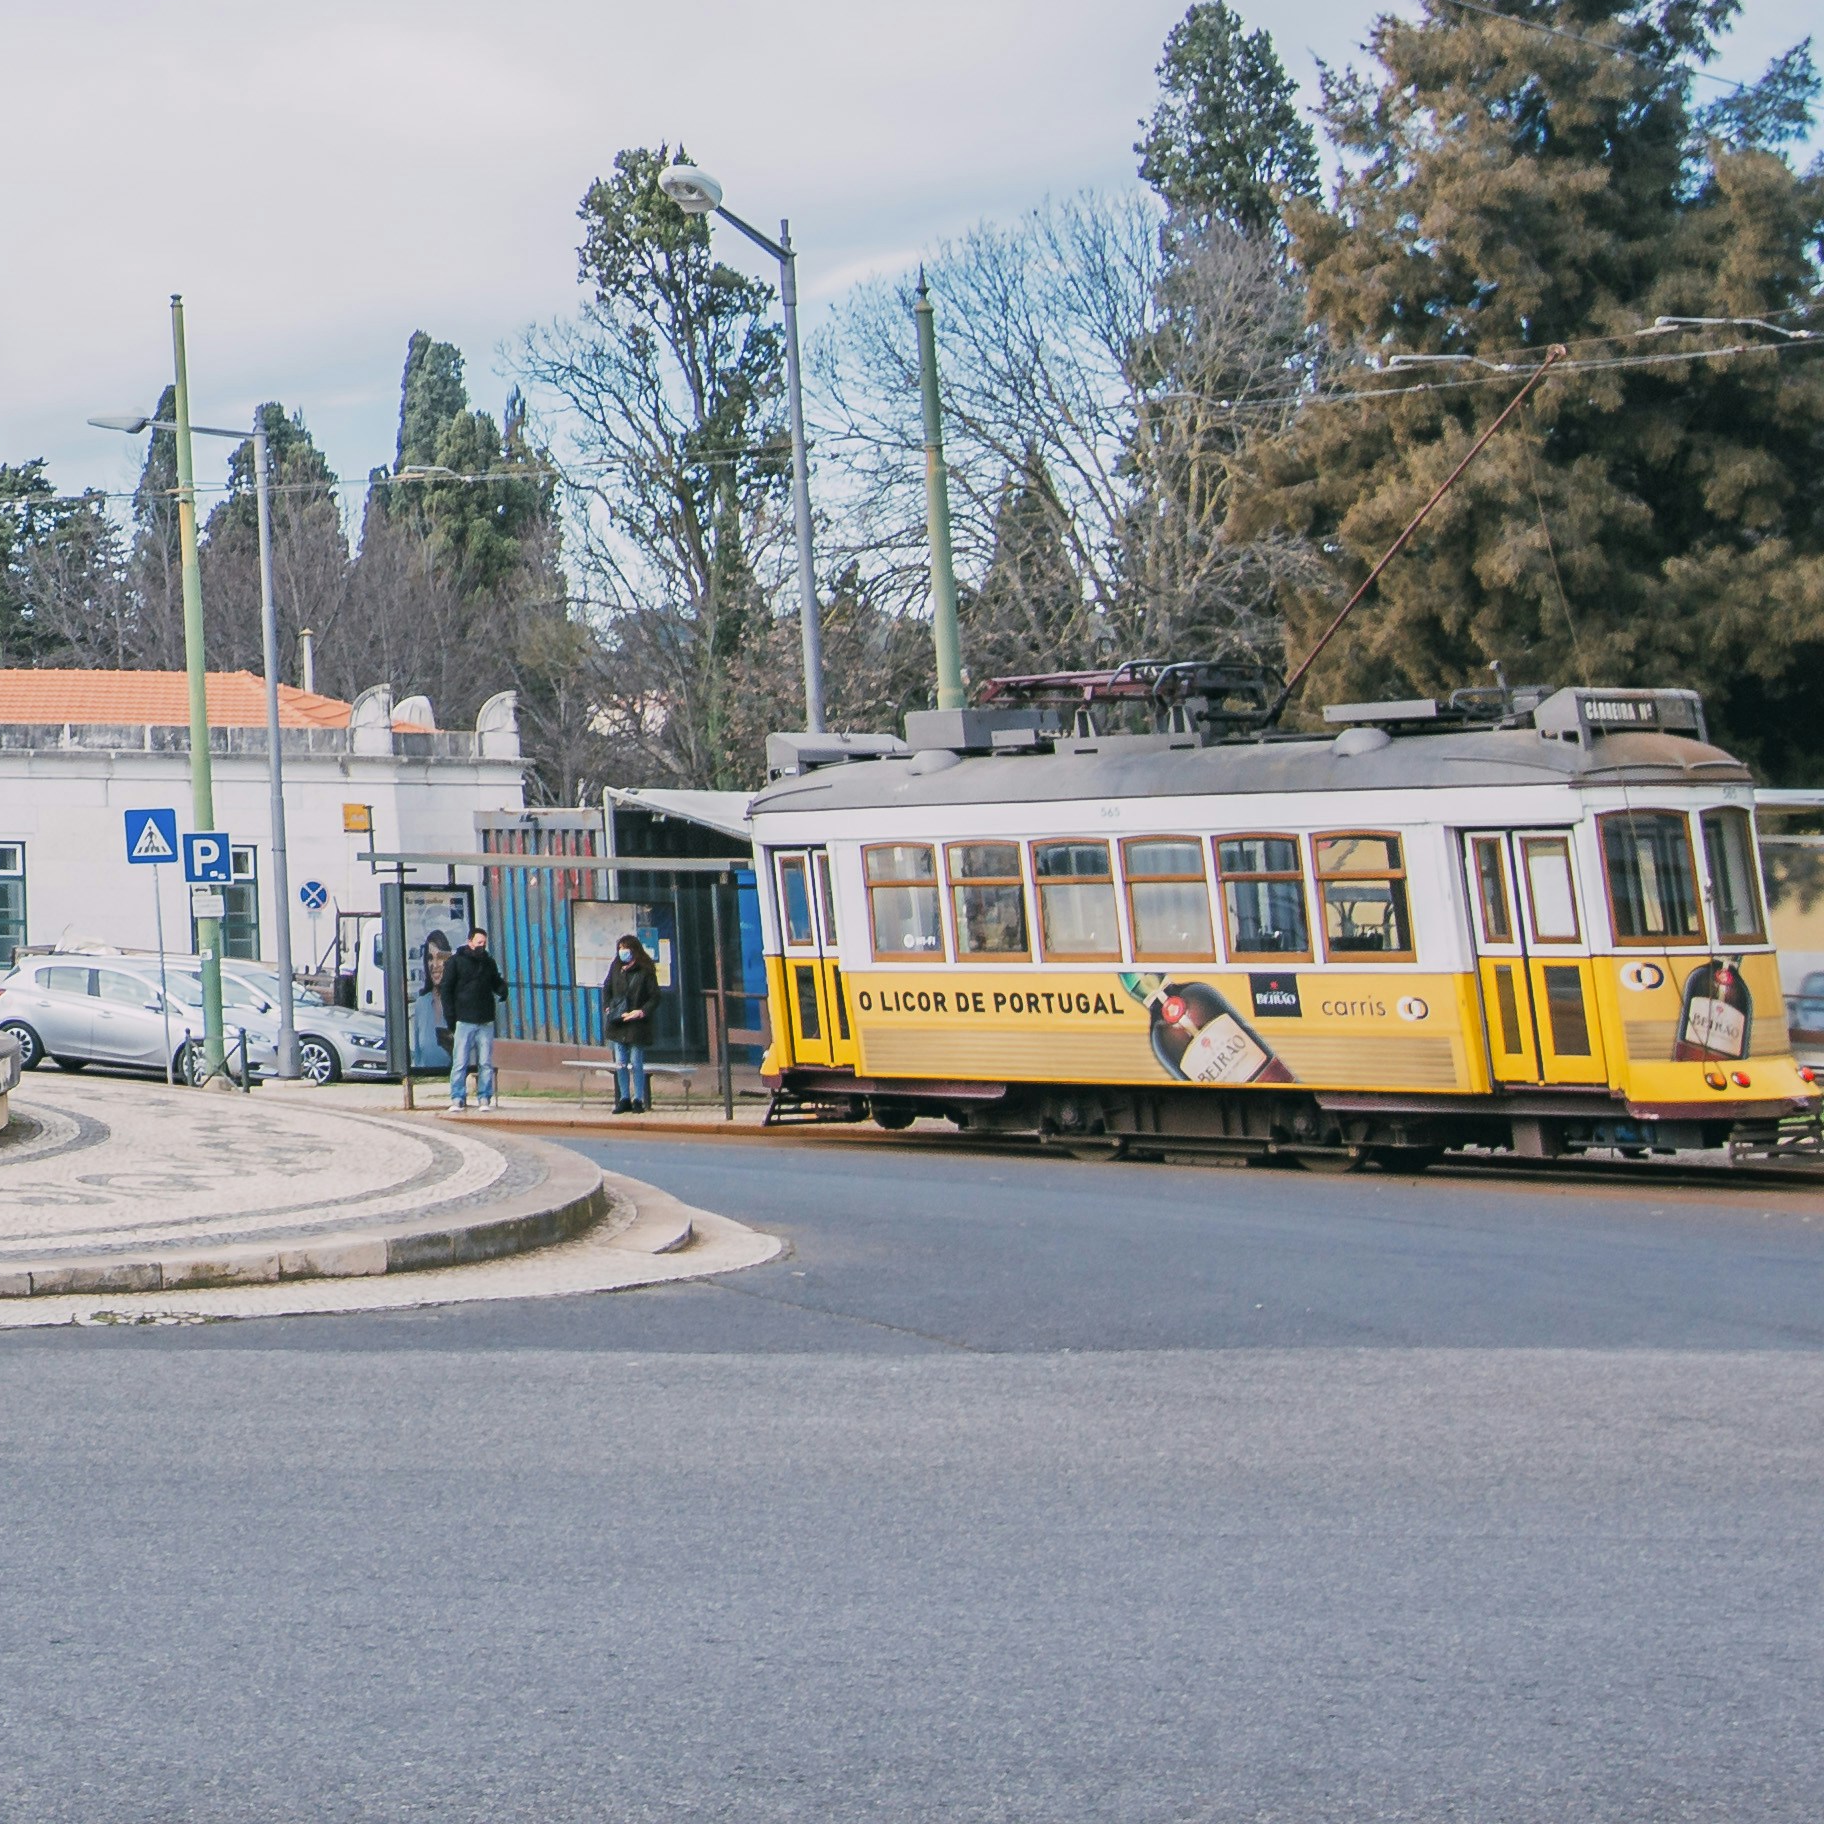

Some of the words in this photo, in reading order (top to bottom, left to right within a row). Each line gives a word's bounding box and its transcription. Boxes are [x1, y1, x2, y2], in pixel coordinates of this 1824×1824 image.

[192, 839, 219, 876] P
[859, 991, 873, 1011] O
[880, 991, 948, 1013] LICOR
[955, 992, 986, 1013] DE
[993, 992, 1125, 1015] PORTUGAL
[1321, 995, 1387, 1017] carris
